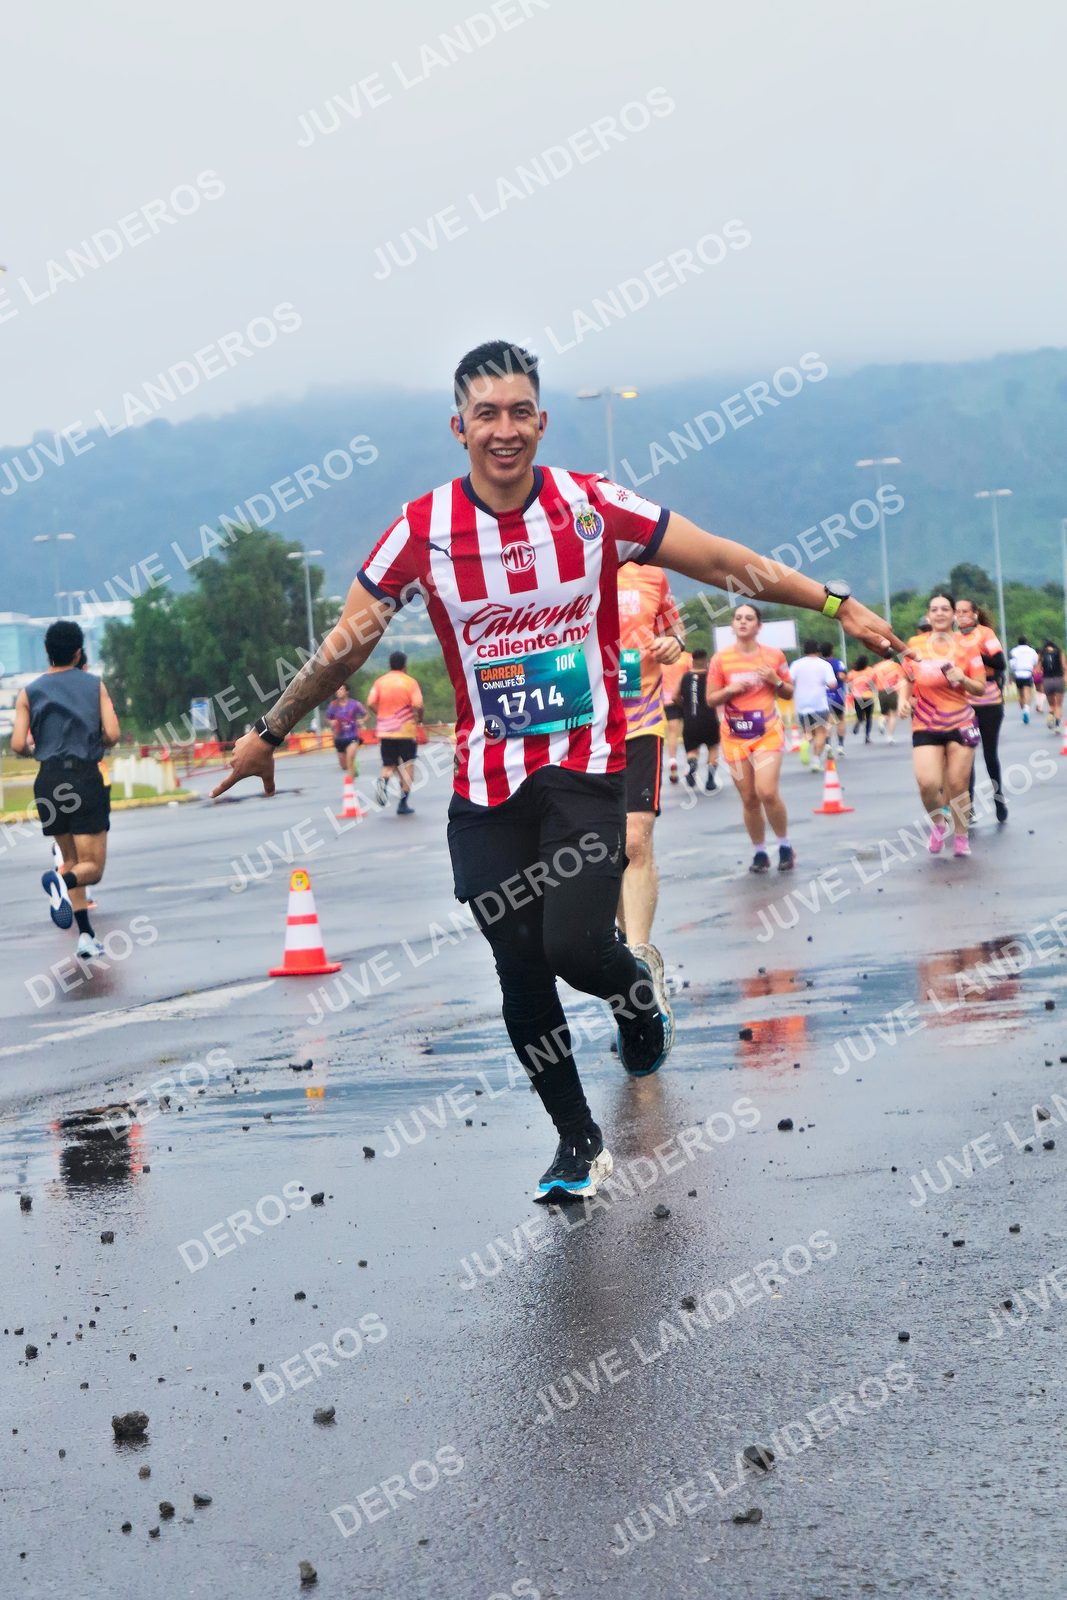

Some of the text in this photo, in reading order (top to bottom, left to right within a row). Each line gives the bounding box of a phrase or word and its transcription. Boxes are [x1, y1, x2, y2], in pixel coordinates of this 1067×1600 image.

[503, 543, 534, 570] MG
[459, 594, 593, 646] Caliente
[476, 622, 591, 658] caliente.mx
[480, 663, 525, 682] CARRERA
[555, 652, 576, 672] 10K
[497, 685, 565, 716] 1714
